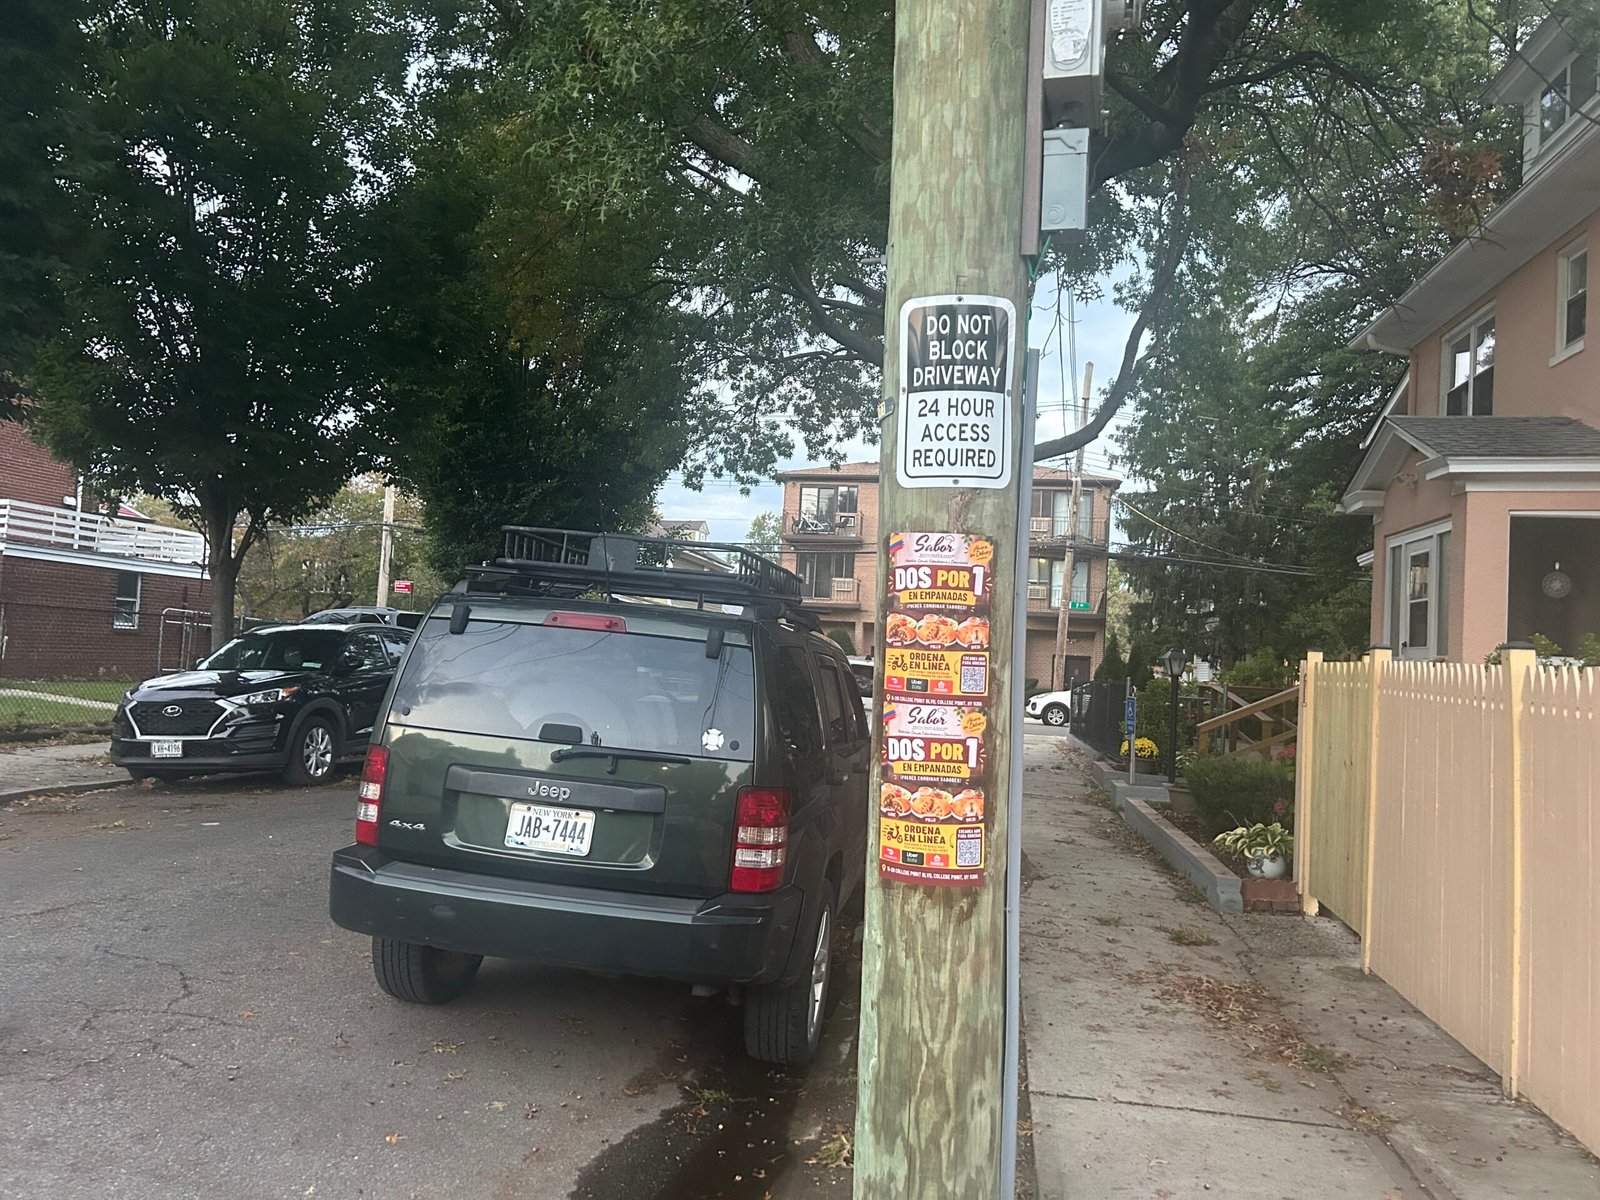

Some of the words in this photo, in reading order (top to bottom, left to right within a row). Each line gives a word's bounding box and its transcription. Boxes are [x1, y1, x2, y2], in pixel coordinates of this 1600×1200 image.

[926, 314, 950, 336] DO
[957, 314, 991, 335] NOT
[929, 340, 988, 360] BLOCK
[913, 365, 1001, 387] DRIVEWAY
[918, 398, 940, 418] 24
[947, 398, 994, 418] HOUR
[921, 423, 990, 443] ACCESS
[913, 448, 996, 468] REQUIRED
[914, 534, 956, 553] Sabor
[895, 567, 932, 590] DOS
[936, 569, 970, 588] POR
[972, 566, 984, 596] 1
[908, 591, 918, 600] EN
[920, 591, 968, 602] EMPANADAS
[909, 652, 946, 662] ORDENA
[909, 661, 920, 670] EN
[908, 706, 947, 725] Sabor
[888, 738, 925, 761] DOS
[930, 742, 963, 760] POR
[966, 738, 978, 768] 1
[902, 763, 912, 772] EN
[914, 763, 962, 774] EMPANADAS
[528, 781, 571, 801] Jeep
[532, 807, 551, 817] NEW
[552, 810, 574, 820] YORK
[389, 819, 426, 831] 4x4
[904, 825, 941, 835] ORDENA
[904, 834, 916, 842] EN
